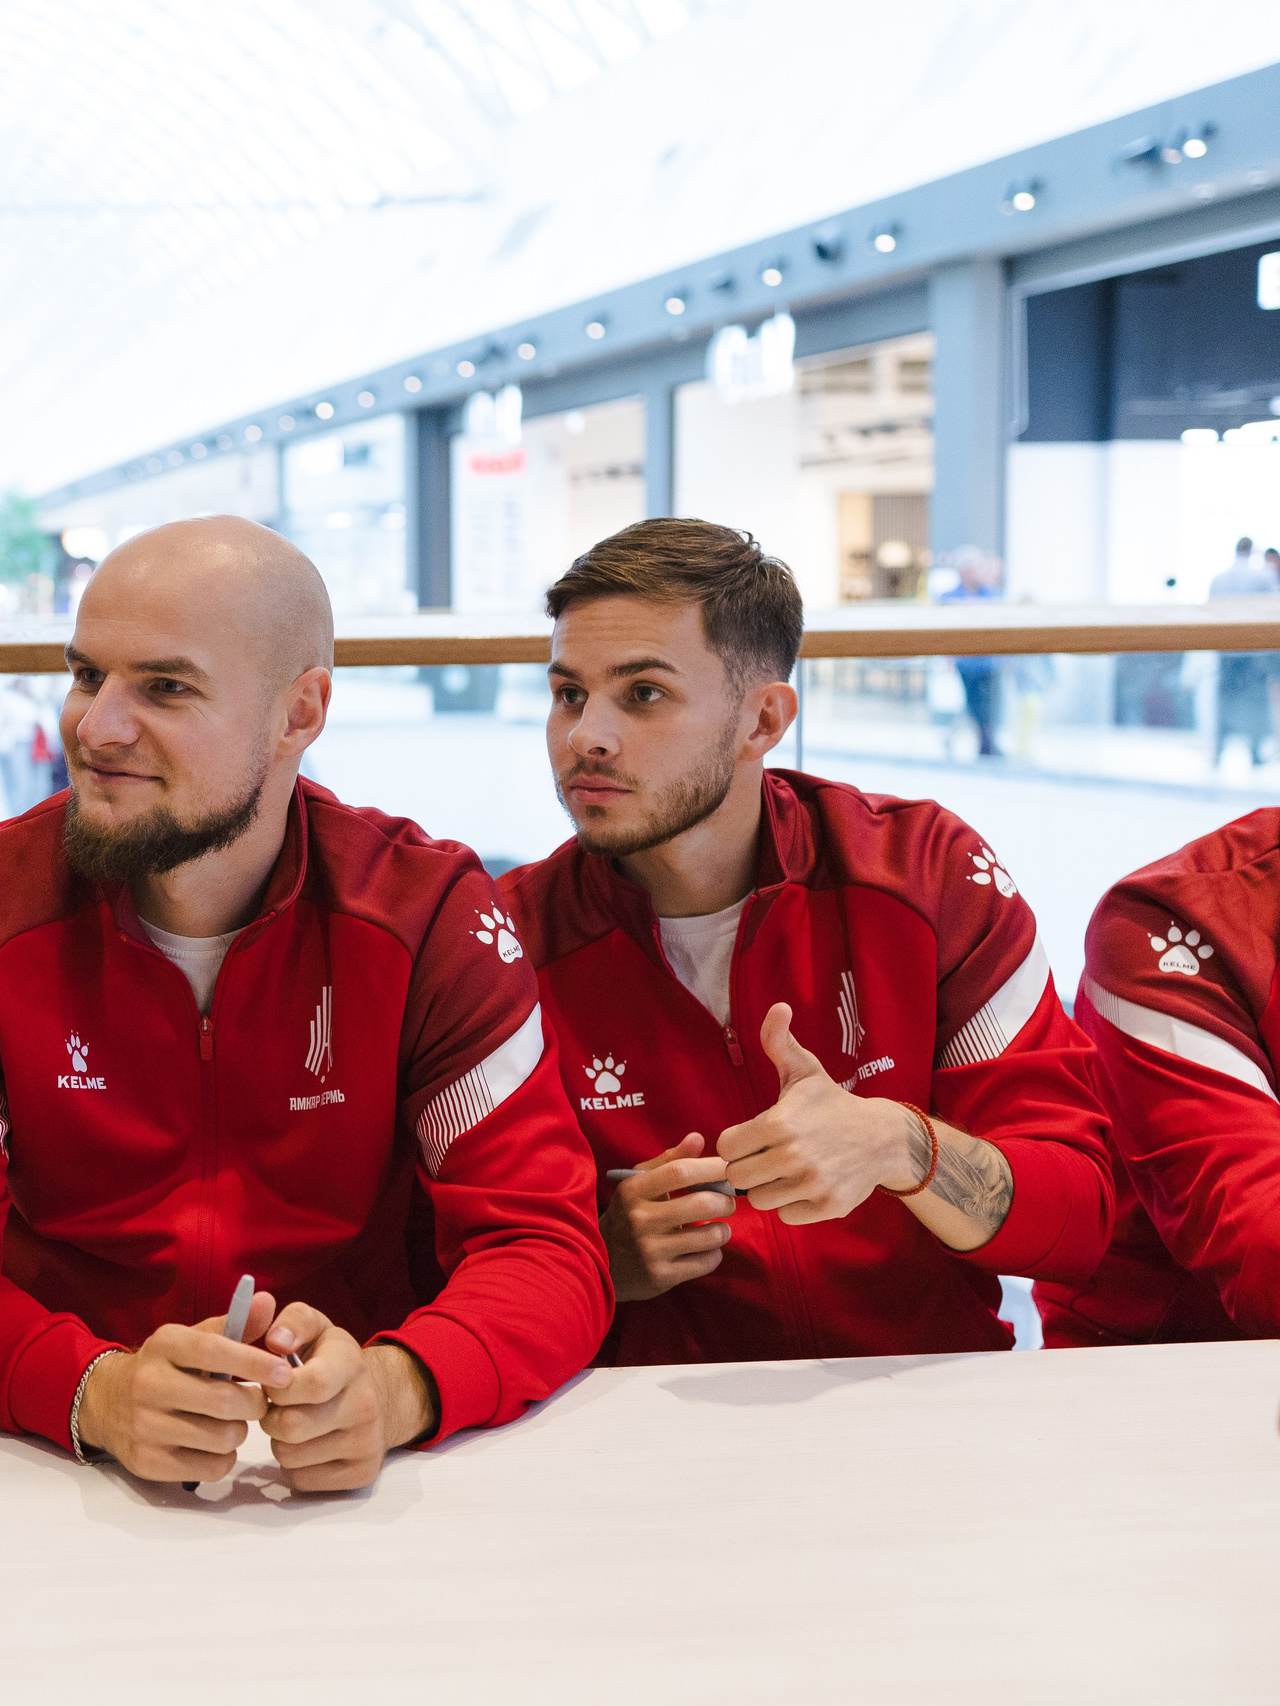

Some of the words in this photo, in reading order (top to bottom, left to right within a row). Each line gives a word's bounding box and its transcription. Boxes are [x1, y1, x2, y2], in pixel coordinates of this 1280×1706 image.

[1163, 961, 1197, 971] KELME
[857, 1055, 895, 1080] ПЕРМЬ
[57, 1075, 107, 1090] KELME
[320, 1089, 345, 1107] ЕРМЬ
[580, 1092, 646, 1110] KELME
